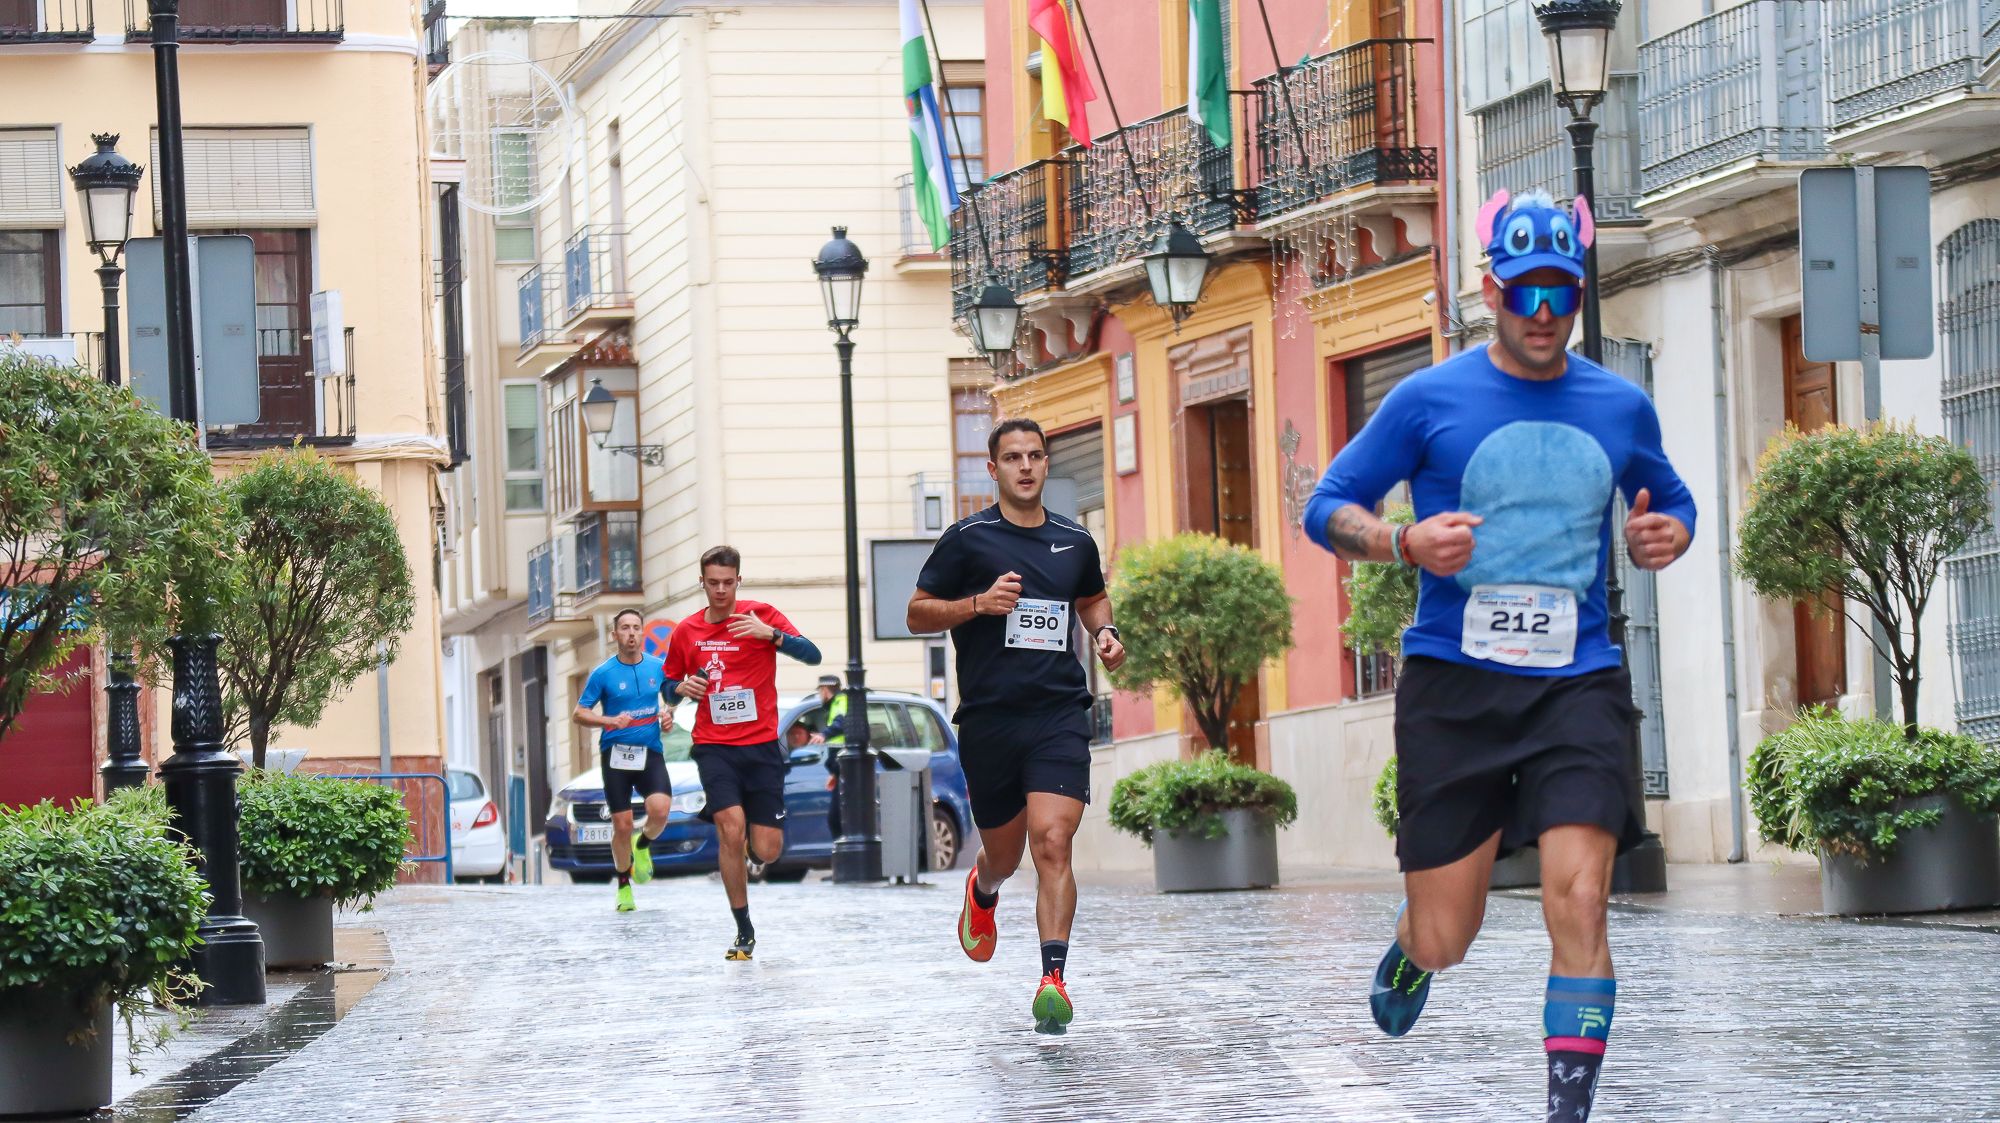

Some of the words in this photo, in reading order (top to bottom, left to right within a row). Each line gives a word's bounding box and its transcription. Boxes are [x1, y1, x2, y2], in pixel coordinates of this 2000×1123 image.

[1019, 614, 1059, 631] 590
[1490, 611, 1550, 635] 212
[719, 700, 746, 712] 428
[622, 753, 635, 761] 18
[584, 829, 609, 841] 2816
